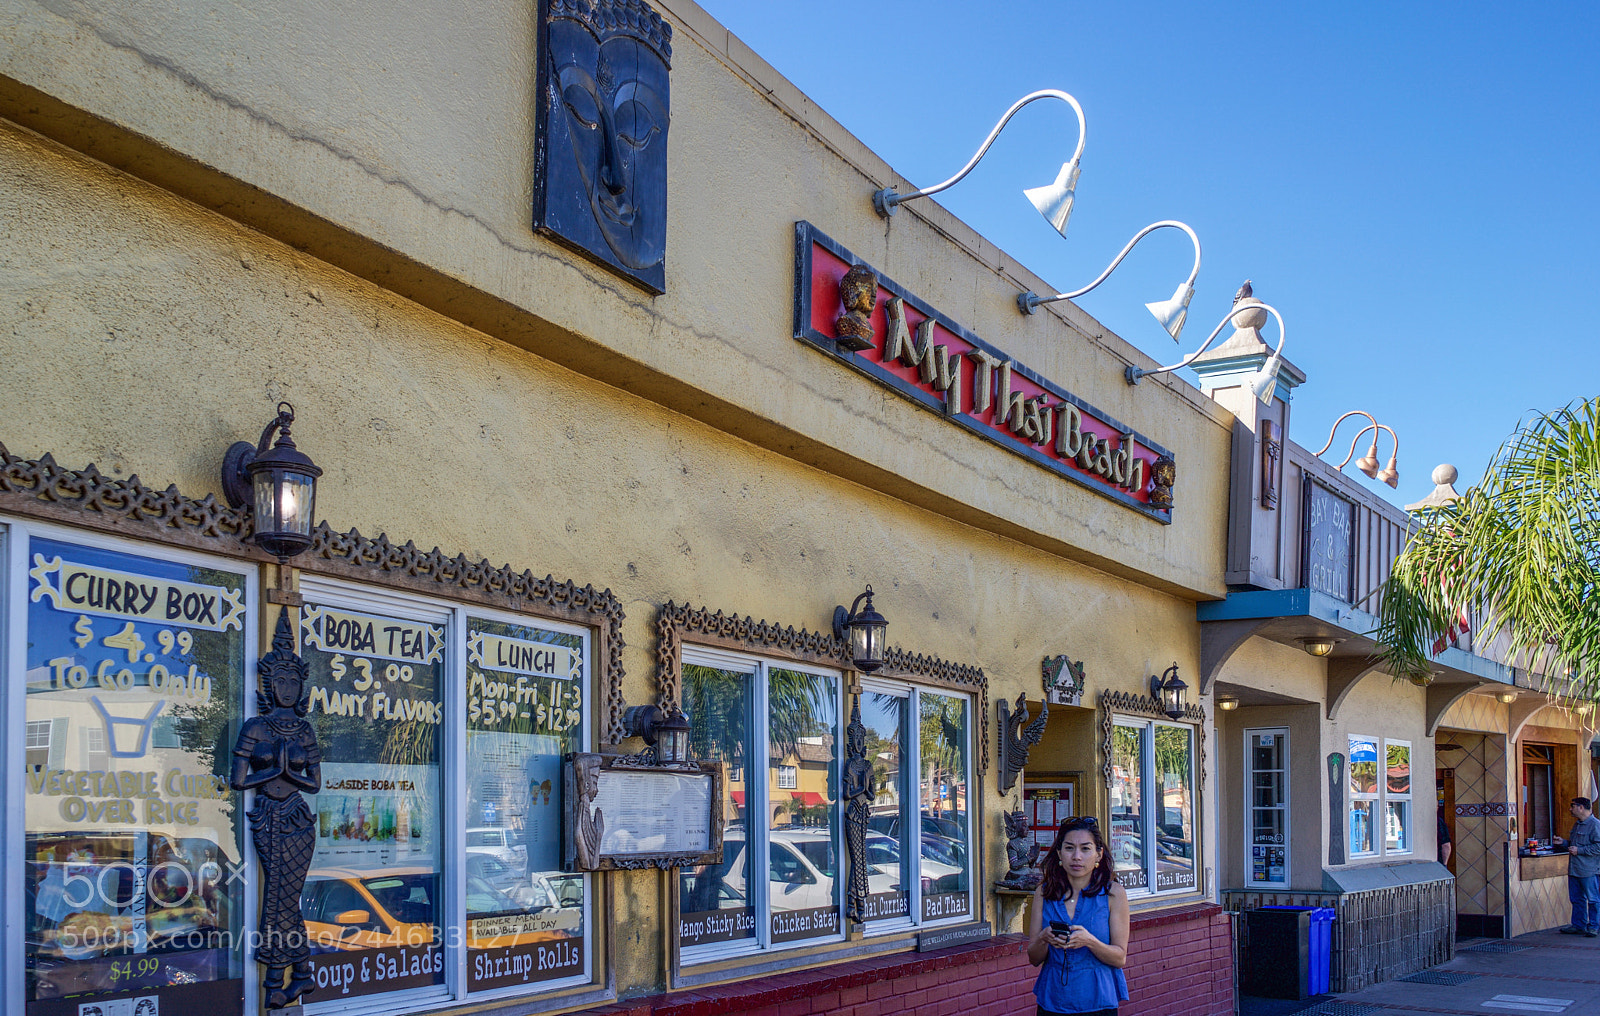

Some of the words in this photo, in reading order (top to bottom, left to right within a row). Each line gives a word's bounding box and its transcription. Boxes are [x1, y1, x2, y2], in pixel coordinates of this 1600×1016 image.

[883, 297, 961, 415] My
[967, 348, 1052, 446] Thai
[1055, 401, 1143, 492] Beach
[1311, 497, 1328, 528] BAY
[1332, 501, 1351, 546] BAR
[1327, 534, 1334, 560] &
[1312, 563, 1345, 599] GRILL
[66, 572, 158, 615] CURRY
[166, 586, 217, 625] BOX
[325, 614, 376, 653] BOBA
[383, 626, 424, 660] TEA
[497, 641, 556, 674] LUNCH
[49, 657, 89, 689] To
[98, 660, 135, 691] Go
[149, 664, 212, 703] Only
[307, 686, 368, 717] MANY
[372, 692, 443, 724] FLAVORS
[469, 696, 517, 725] $5.99
[536, 703, 581, 732] $12.99
[371, 780, 396, 791] BOBA
[398, 780, 415, 791] TEA
[63, 796, 137, 823] OVER
[146, 797, 200, 826] RICE
[1128, 872, 1136, 886] To
[1138, 871, 1147, 885] Go
[1158, 873, 1173, 886] Thai
[1175, 872, 1193, 886] Wraps
[134, 892, 146, 930] SIAM
[476, 917, 511, 928] DINNER
[515, 914, 542, 923] MENU
[864, 896, 877, 918] hai
[880, 894, 907, 915] Curries
[926, 896, 943, 917] Pad
[945, 894, 966, 914] Thai
[475, 925, 518, 937] AVAILABLE
[523, 923, 537, 933] ALL
[542, 920, 557, 929] DAY
[680, 920, 703, 941] Mango
[706, 914, 734, 936] Sticky
[736, 912, 755, 930] Rice
[773, 912, 811, 935] Chicken
[813, 911, 838, 932] Satay
[109, 957, 159, 983] $4.99
[360, 957, 370, 983] &
[375, 946, 443, 981] Salads
[475, 949, 533, 981] Shrimp
[538, 942, 579, 971] Rolls
